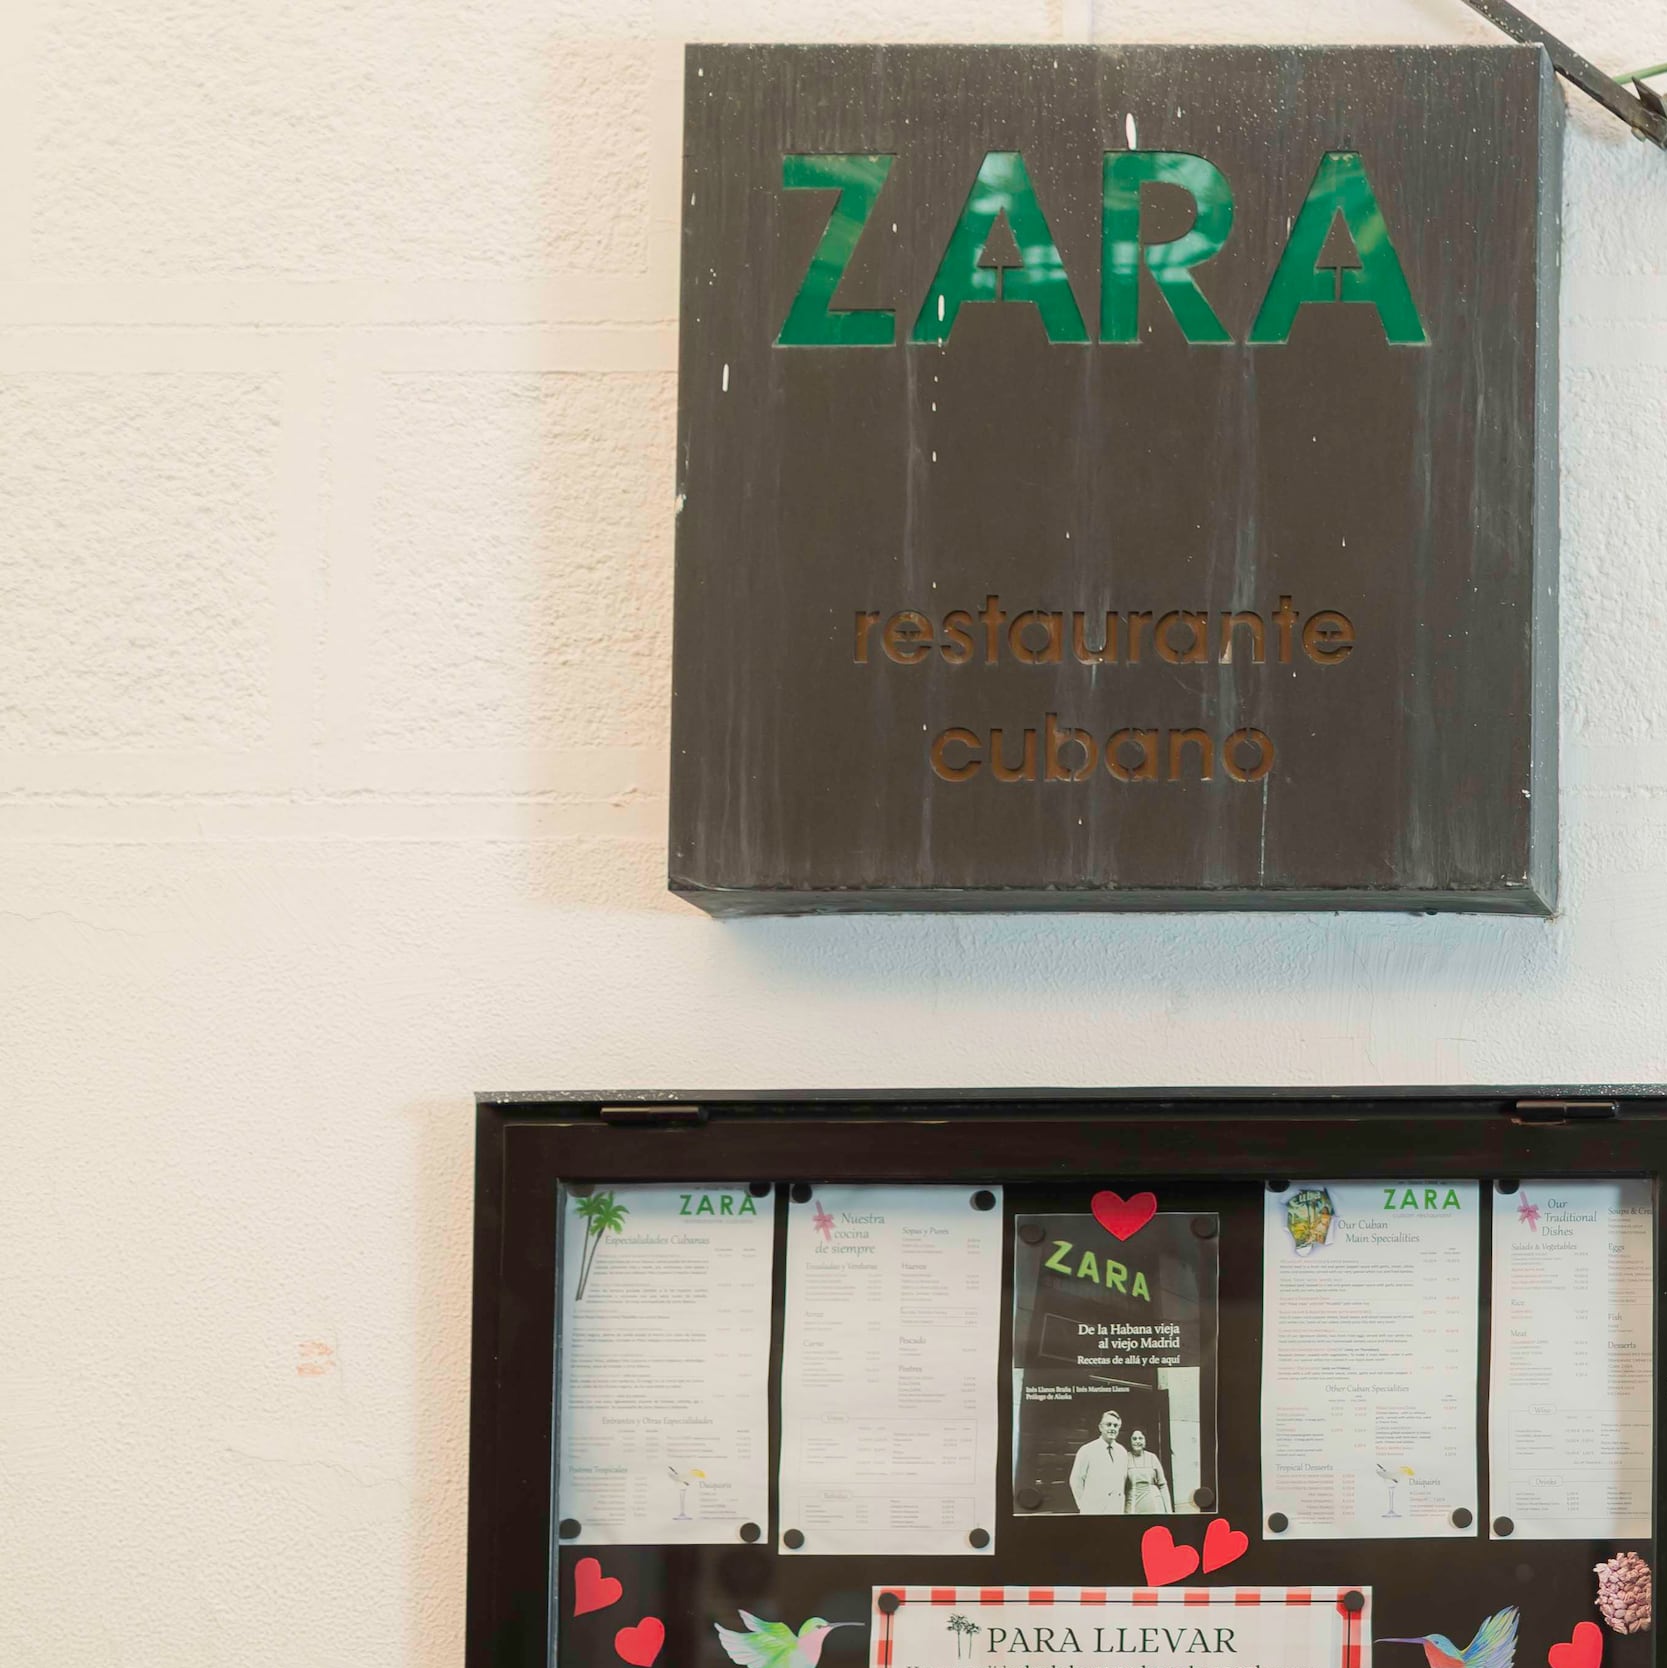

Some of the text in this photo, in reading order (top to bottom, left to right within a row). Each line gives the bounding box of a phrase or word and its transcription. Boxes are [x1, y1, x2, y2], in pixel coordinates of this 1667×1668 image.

[772, 149, 1431, 347] ZARA
[853, 594, 1356, 666] restaurante
[929, 714, 1276, 783] cubano
[680, 1194, 757, 1216] ZARA
[1383, 1188, 1461, 1210] ZARA
[1547, 1198, 1567, 1209] Our
[841, 1212, 885, 1224] Nuestra
[1544, 1210, 1597, 1222] Traditional
[1338, 1219, 1388, 1230] Our Cuban
[1542, 1225, 1574, 1236] Dishes
[834, 1228, 869, 1239] cocina
[1345, 1233, 1420, 1245] Main Specialities
[815, 1241, 875, 1257] de siempre
[1044, 1240, 1150, 1302] ZARA
[1078, 1324, 1180, 1338] De la Habana vieja
[1098, 1338, 1180, 1351] al viejo Madrid
[1077, 1355, 1180, 1367] Recetas de allá y de aquí
[986, 1627, 1238, 1654] PARA LLEVAR
